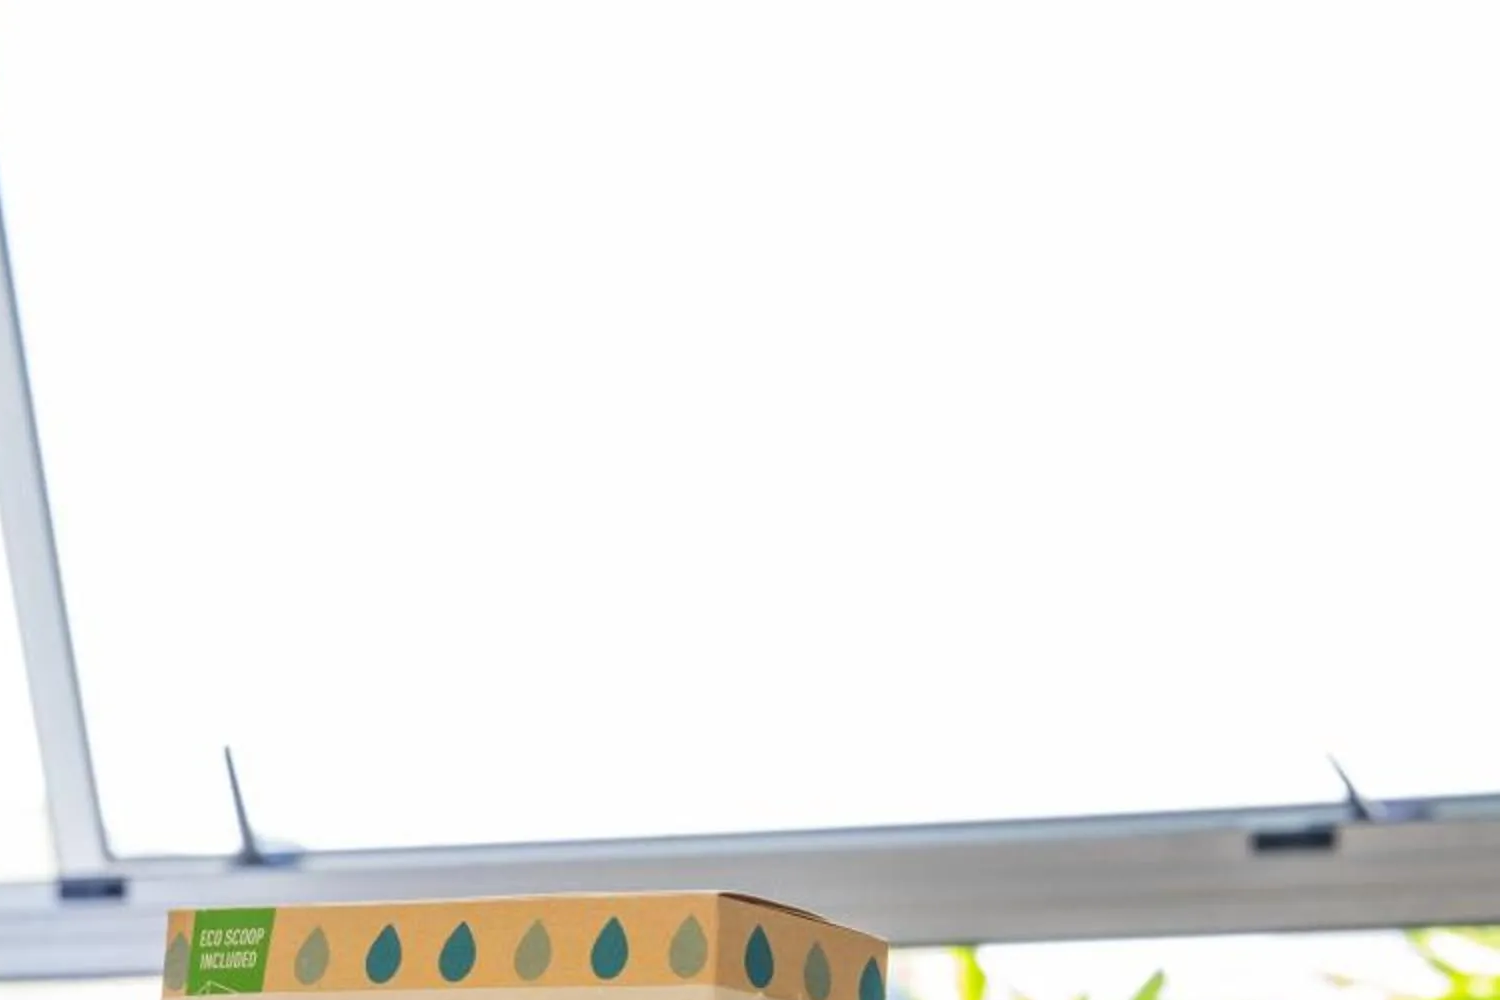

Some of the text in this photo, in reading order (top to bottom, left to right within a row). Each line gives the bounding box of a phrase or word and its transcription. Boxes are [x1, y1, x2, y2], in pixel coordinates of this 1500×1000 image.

[200, 926, 266, 947] ECO SCOOP
[200, 950, 259, 970] INCLUDED
